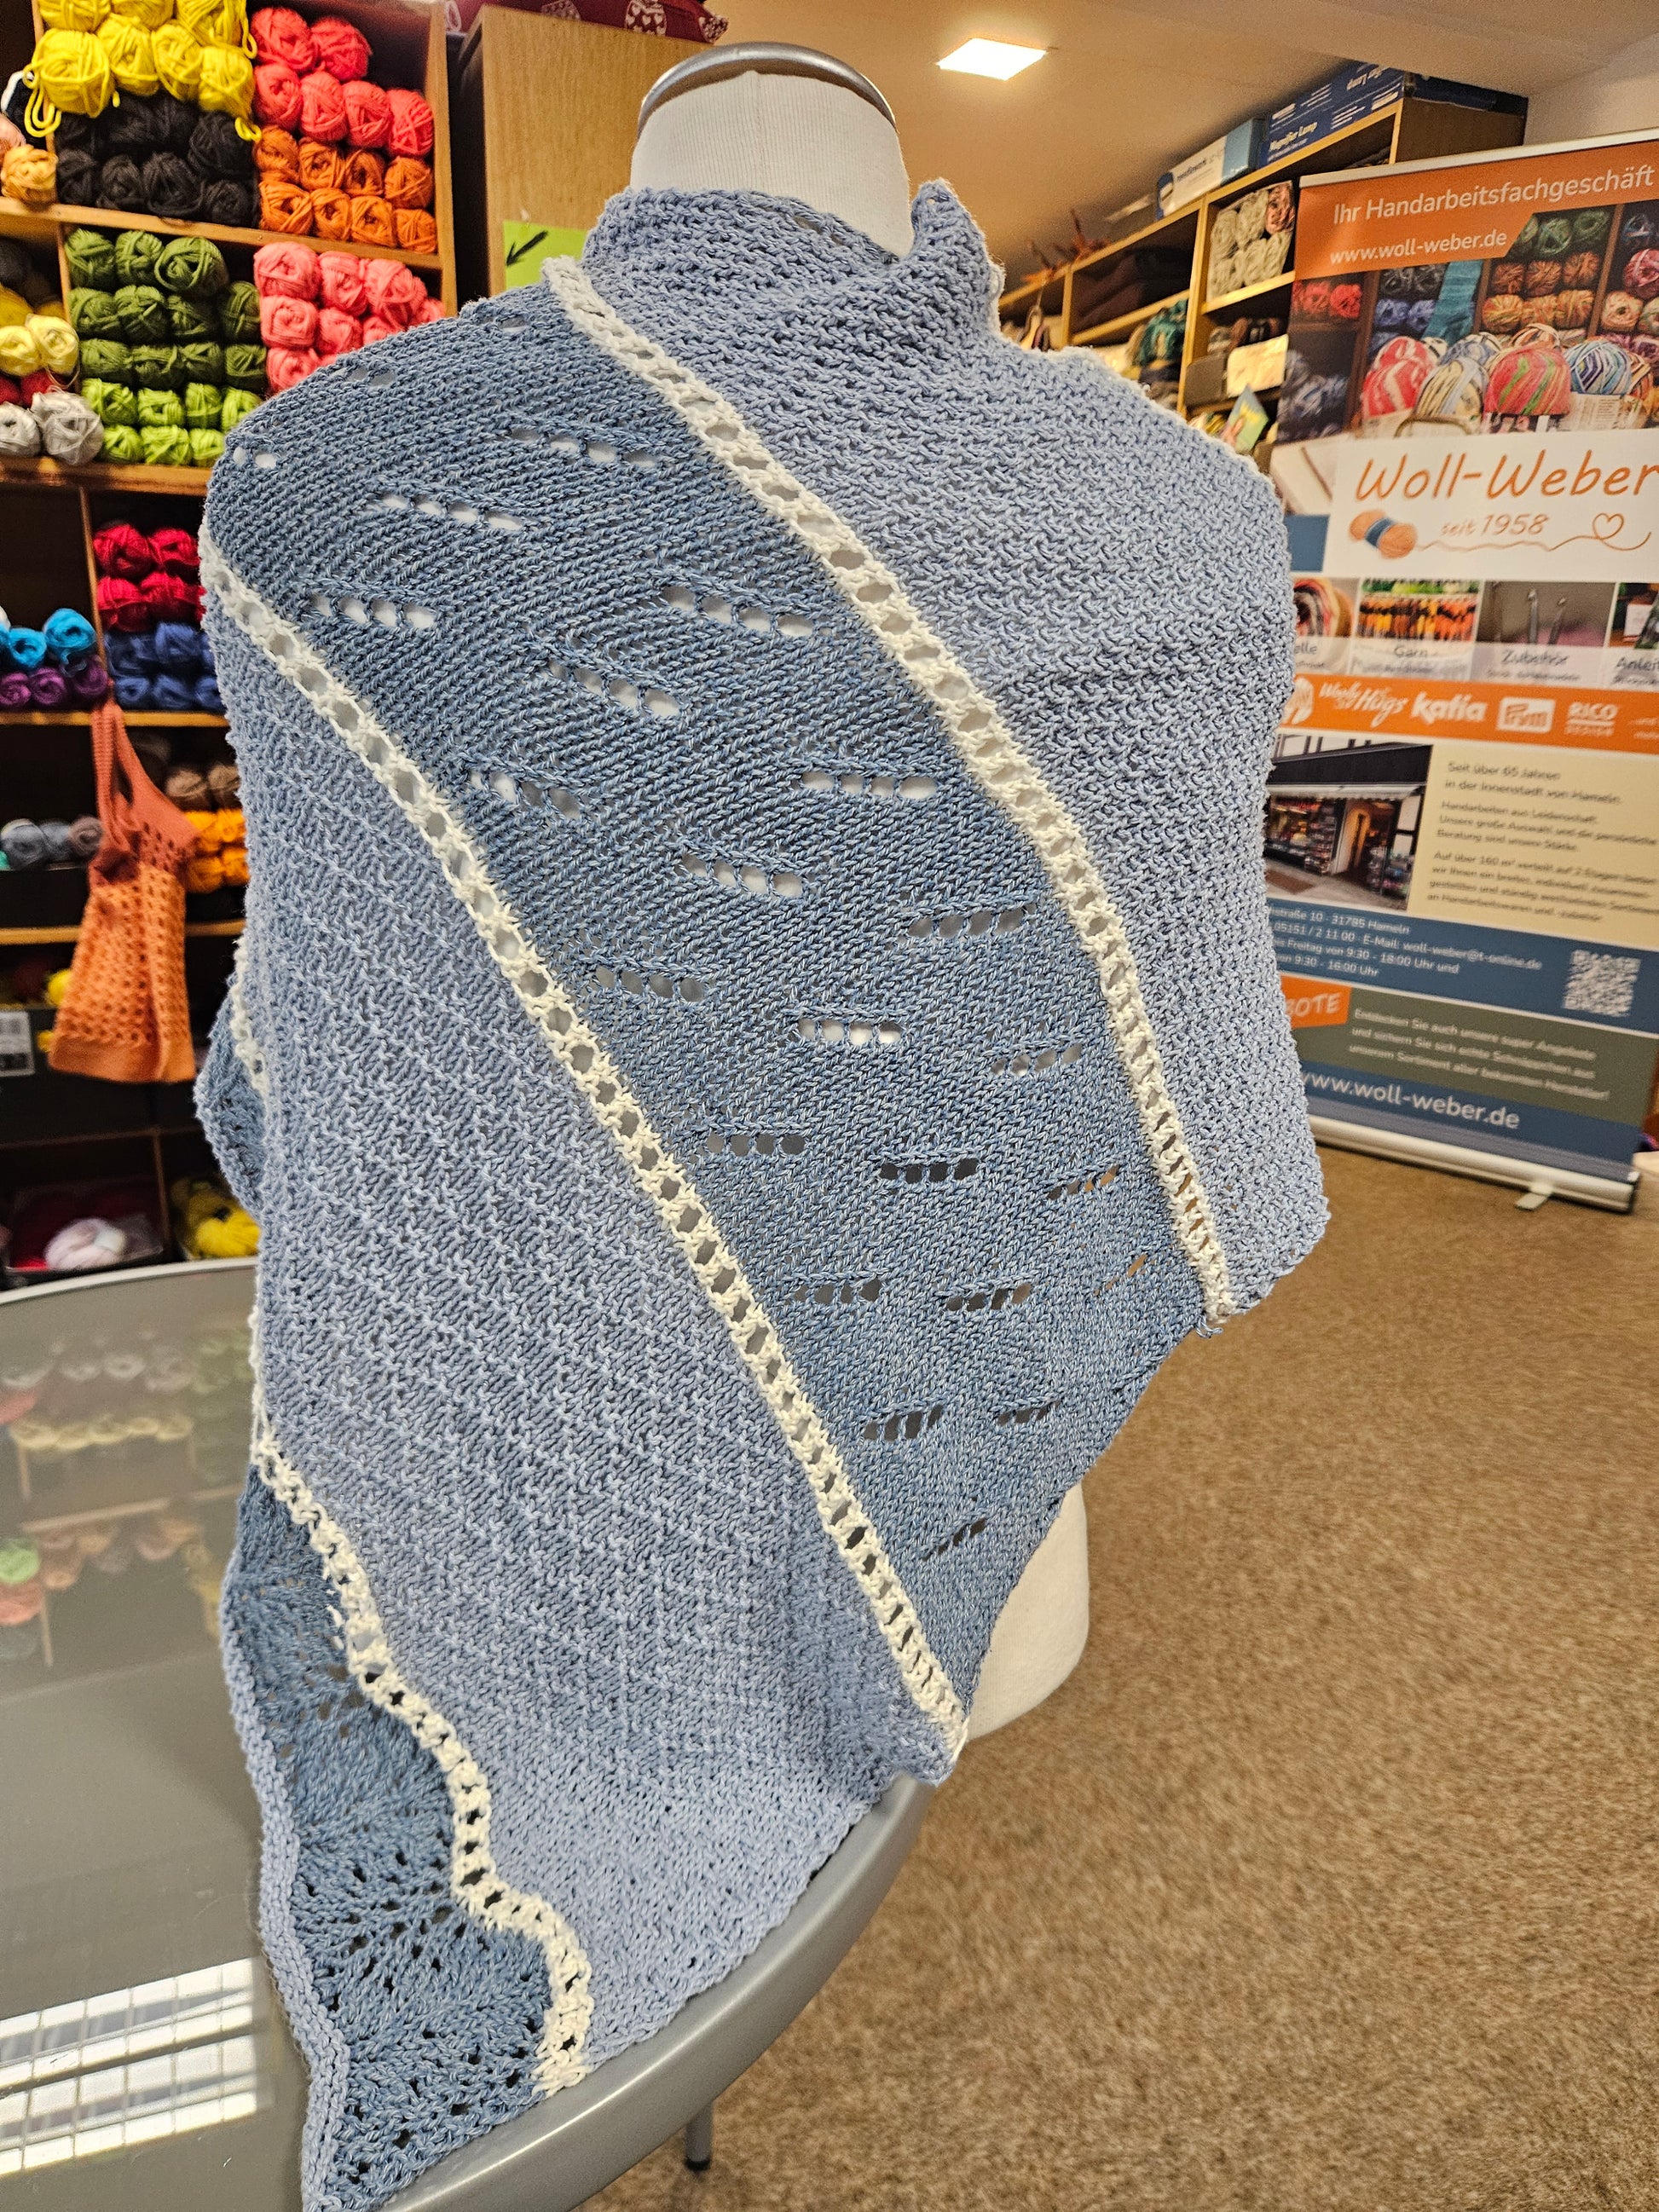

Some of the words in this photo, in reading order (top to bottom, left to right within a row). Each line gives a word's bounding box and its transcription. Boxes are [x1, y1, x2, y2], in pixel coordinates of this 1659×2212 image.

[1333, 203, 1361, 224] Ihr
[1366, 165, 1656, 220] Handarbeitsfachgeschäft
[1329, 229, 1508, 264] www.woll-weber.de
[1355, 449, 1659, 501] Woll-Weber
[1441, 516, 1477, 536] seit
[1482, 513, 1550, 536] 1958
[1394, 644, 1428, 658] Garn
[1411, 691, 1488, 725] katia
[1568, 701, 1619, 721] RICO
[1448, 761, 1471, 772] Seit
[1473, 764, 1500, 775] über
[1445, 779, 1456, 788] in
[1459, 781, 1477, 790] der
[1434, 851, 1452, 861] Auf
[1454, 852, 1476, 863] über
[1309, 911, 1323, 922] 10
[1331, 915, 1366, 928] 31785
[1367, 920, 1411, 934] Hameln
[1287, 939, 1322, 956] Freitag
[1326, 947, 1344, 956] von
[1346, 948, 1370, 961] 9:30
[1414, 958, 1434, 970] Uhr
[1436, 962, 1460, 974] und
[1294, 955, 1318, 968] 9:30
[1359, 964, 1380, 978] Uhr
[1411, 1017, 1430, 1031] Sie
[1350, 1027, 1373, 1038] und
[1414, 1036, 1433, 1049] Sie
